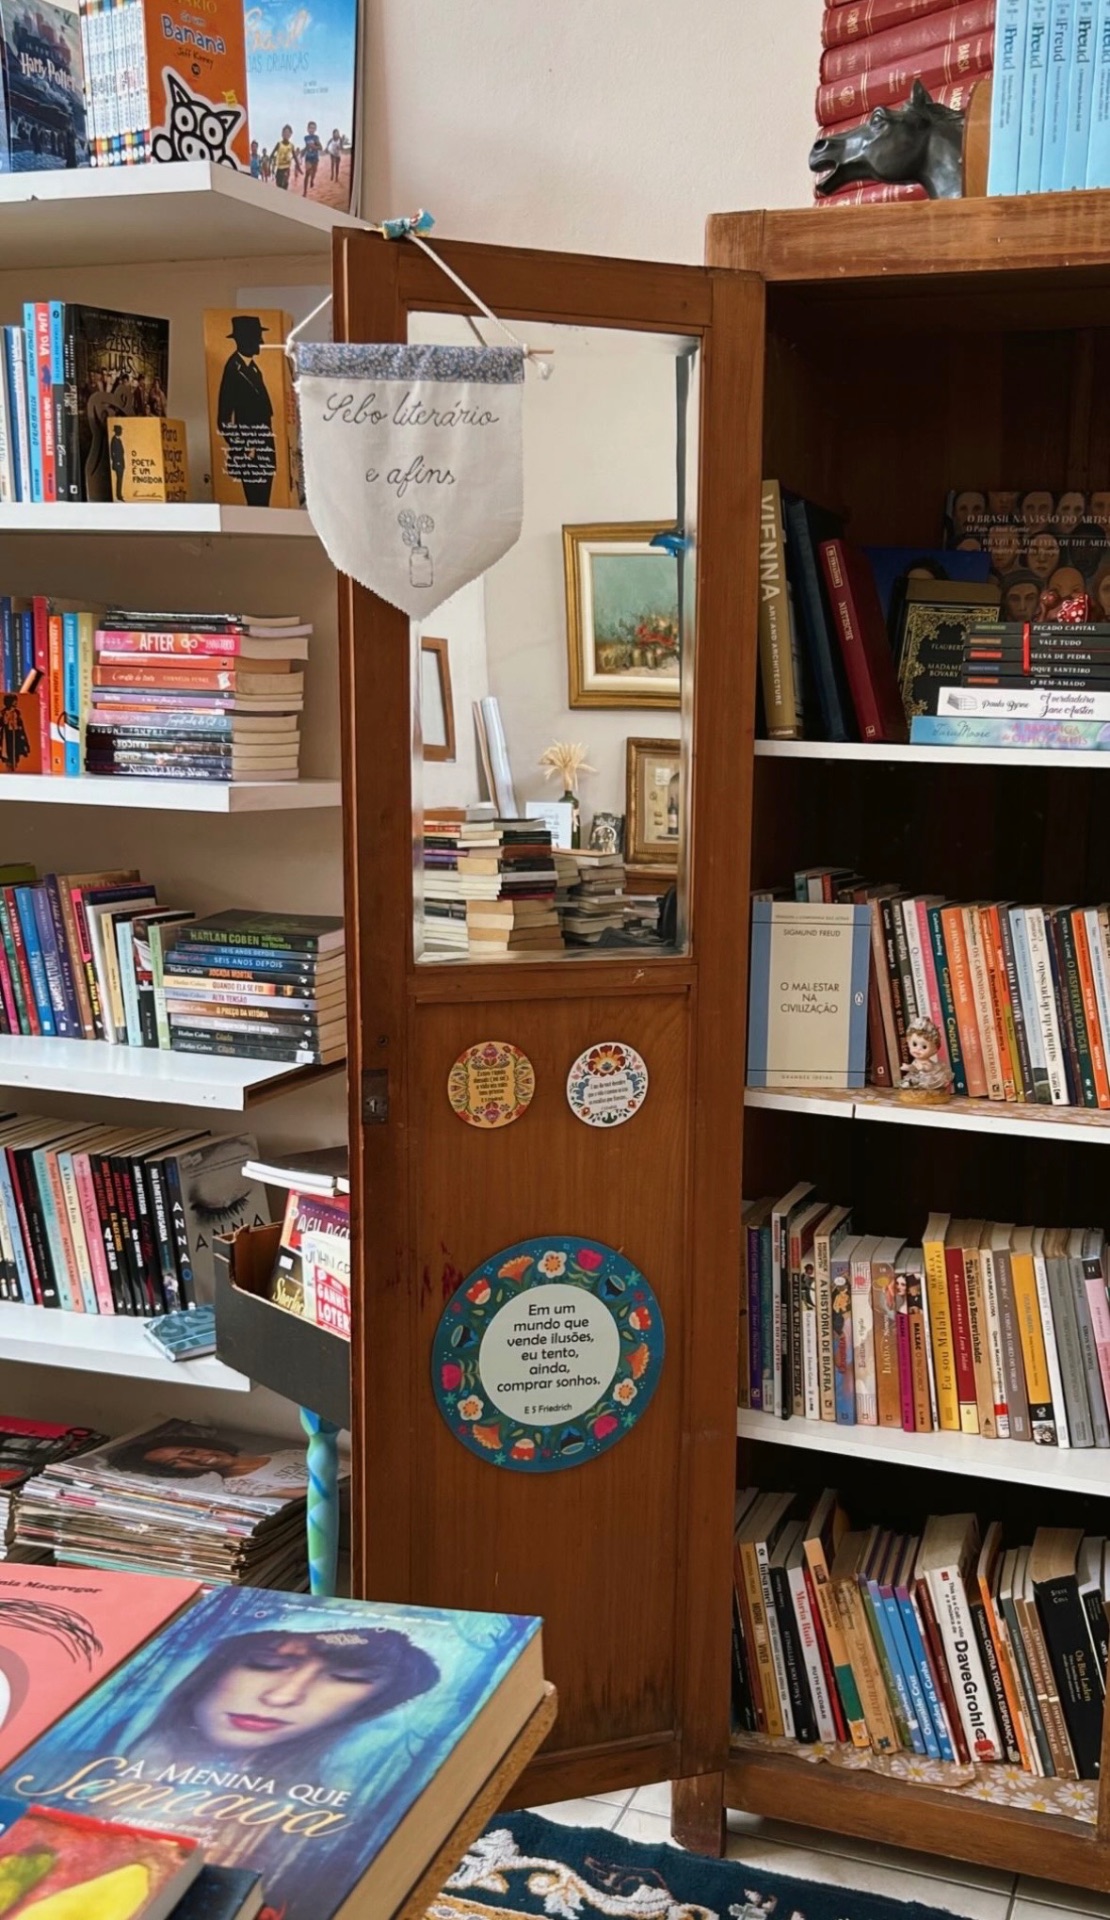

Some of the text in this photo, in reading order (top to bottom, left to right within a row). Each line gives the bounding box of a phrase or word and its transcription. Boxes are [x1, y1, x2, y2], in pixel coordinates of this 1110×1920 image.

[161, 14, 226, 55] Banana
[1001, 27, 1018, 70] Freud
[1029, 25, 1045, 69] Freud
[1052, 21, 1068, 63] Freud
[1076, 19, 1092, 64] Freud
[20, 53, 77, 90] Harry Potter
[957, 43, 971, 74] BARSA
[37, 312, 50, 357] UM DIA
[322, 391, 500, 428] Sebo literário
[131, 459, 156, 467] POETA
[132, 466, 137, 475] É
[365, 455, 457, 499] e afins
[132, 475, 163, 484] FINGIDOR
[967, 515, 976, 523] O
[979, 515, 1009, 523] BRASIL
[1014, 515, 1026, 524] NA
[1027, 514, 1057, 524] VISÃO
[1062, 516, 1077, 524] DO
[760, 494, 782, 706] VIENNA ART AND ARCHITECTURE
[139, 635, 175, 652] AFTER
[929, 670, 959, 678] BOVARY
[981, 700, 1031, 711] Paula Byrne
[1040, 704, 1095, 718] Jane Austen
[190, 931, 260, 945] HARLAN COBEN
[783, 929, 841, 937] SIGMUND FREUD
[208, 969, 254, 980] JOGADA MORTAL
[214, 957, 284, 969] SEIS ANOS DEPOIS
[211, 994, 248, 1004] ALTA TENSÃO
[212, 981, 265, 993] QUANDO ELA SE FOI
[780, 982, 839, 992] O MAL-ESTAR
[802, 994, 817, 1002] NA
[1038, 960, 1051, 1012] depressão
[1068, 970, 1083, 1014] DESPERTAR
[221, 1007, 239, 1017] PREÇO
[240, 1008, 247, 1016] DA
[248, 1008, 269, 1018] VITÓRIA
[780, 1003, 838, 1014] CIVILIZAÇÃO
[972, 947, 998, 1079] OS CAMINHOS DO MUNDO INTERIOR
[1042, 1013, 1052, 1026] da
[1075, 1016, 1085, 1029] DO
[1078, 1031, 1089, 1054] TIGRE
[133, 1165, 147, 1215] JAMES PATTERSON
[172, 1201, 190, 1263] ANNA
[929, 1257, 937, 1289] MALALA
[936, 1250, 945, 1296] YOUSAFZAI
[528, 1304, 576, 1316] Em um
[821, 1290, 831, 1338] HISTÓRIA
[965, 1260, 974, 1274] Tia
[970, 1307, 982, 1364] Escrevinhador
[507, 1332, 594, 1347] vende ilusões,
[513, 1319, 589, 1332] mundo que
[913, 1323, 921, 1350] BALZAC
[521, 1348, 579, 1361] eu tento,
[822, 1340, 830, 1353] DE
[937, 1310, 952, 1391] Eu sou Malala
[529, 1362, 570, 1375] ainda,
[822, 1356, 831, 1392] BIAFRA
[497, 1375, 601, 1393] comprar sonhos.
[524, 1403, 572, 1414] E S Friedrich
[26, 1580, 103, 1594] Macgregor
[760, 1563, 774, 1608] luisa mell
[797, 1590, 814, 1648] Maria Ruth
[919, 1660, 933, 1689] Cunha
[954, 1640, 985, 1727] DaveGrohl
[1075, 1650, 1092, 1702] Os Bin Laden
[811, 1666, 826, 1720] RUTH ESCOBAR
[909, 1675, 932, 1736] Oswaldo Cruz
[928, 1691, 937, 1702] da
[984, 1640, 995, 1670] CONTRA
[991, 1671, 1000, 1692] TODA
[998, 1701, 1012, 1745] ESPERANÇA
[14, 1756, 355, 1838] Semeava
[118, 1759, 352, 1808] A MENINA QUE
